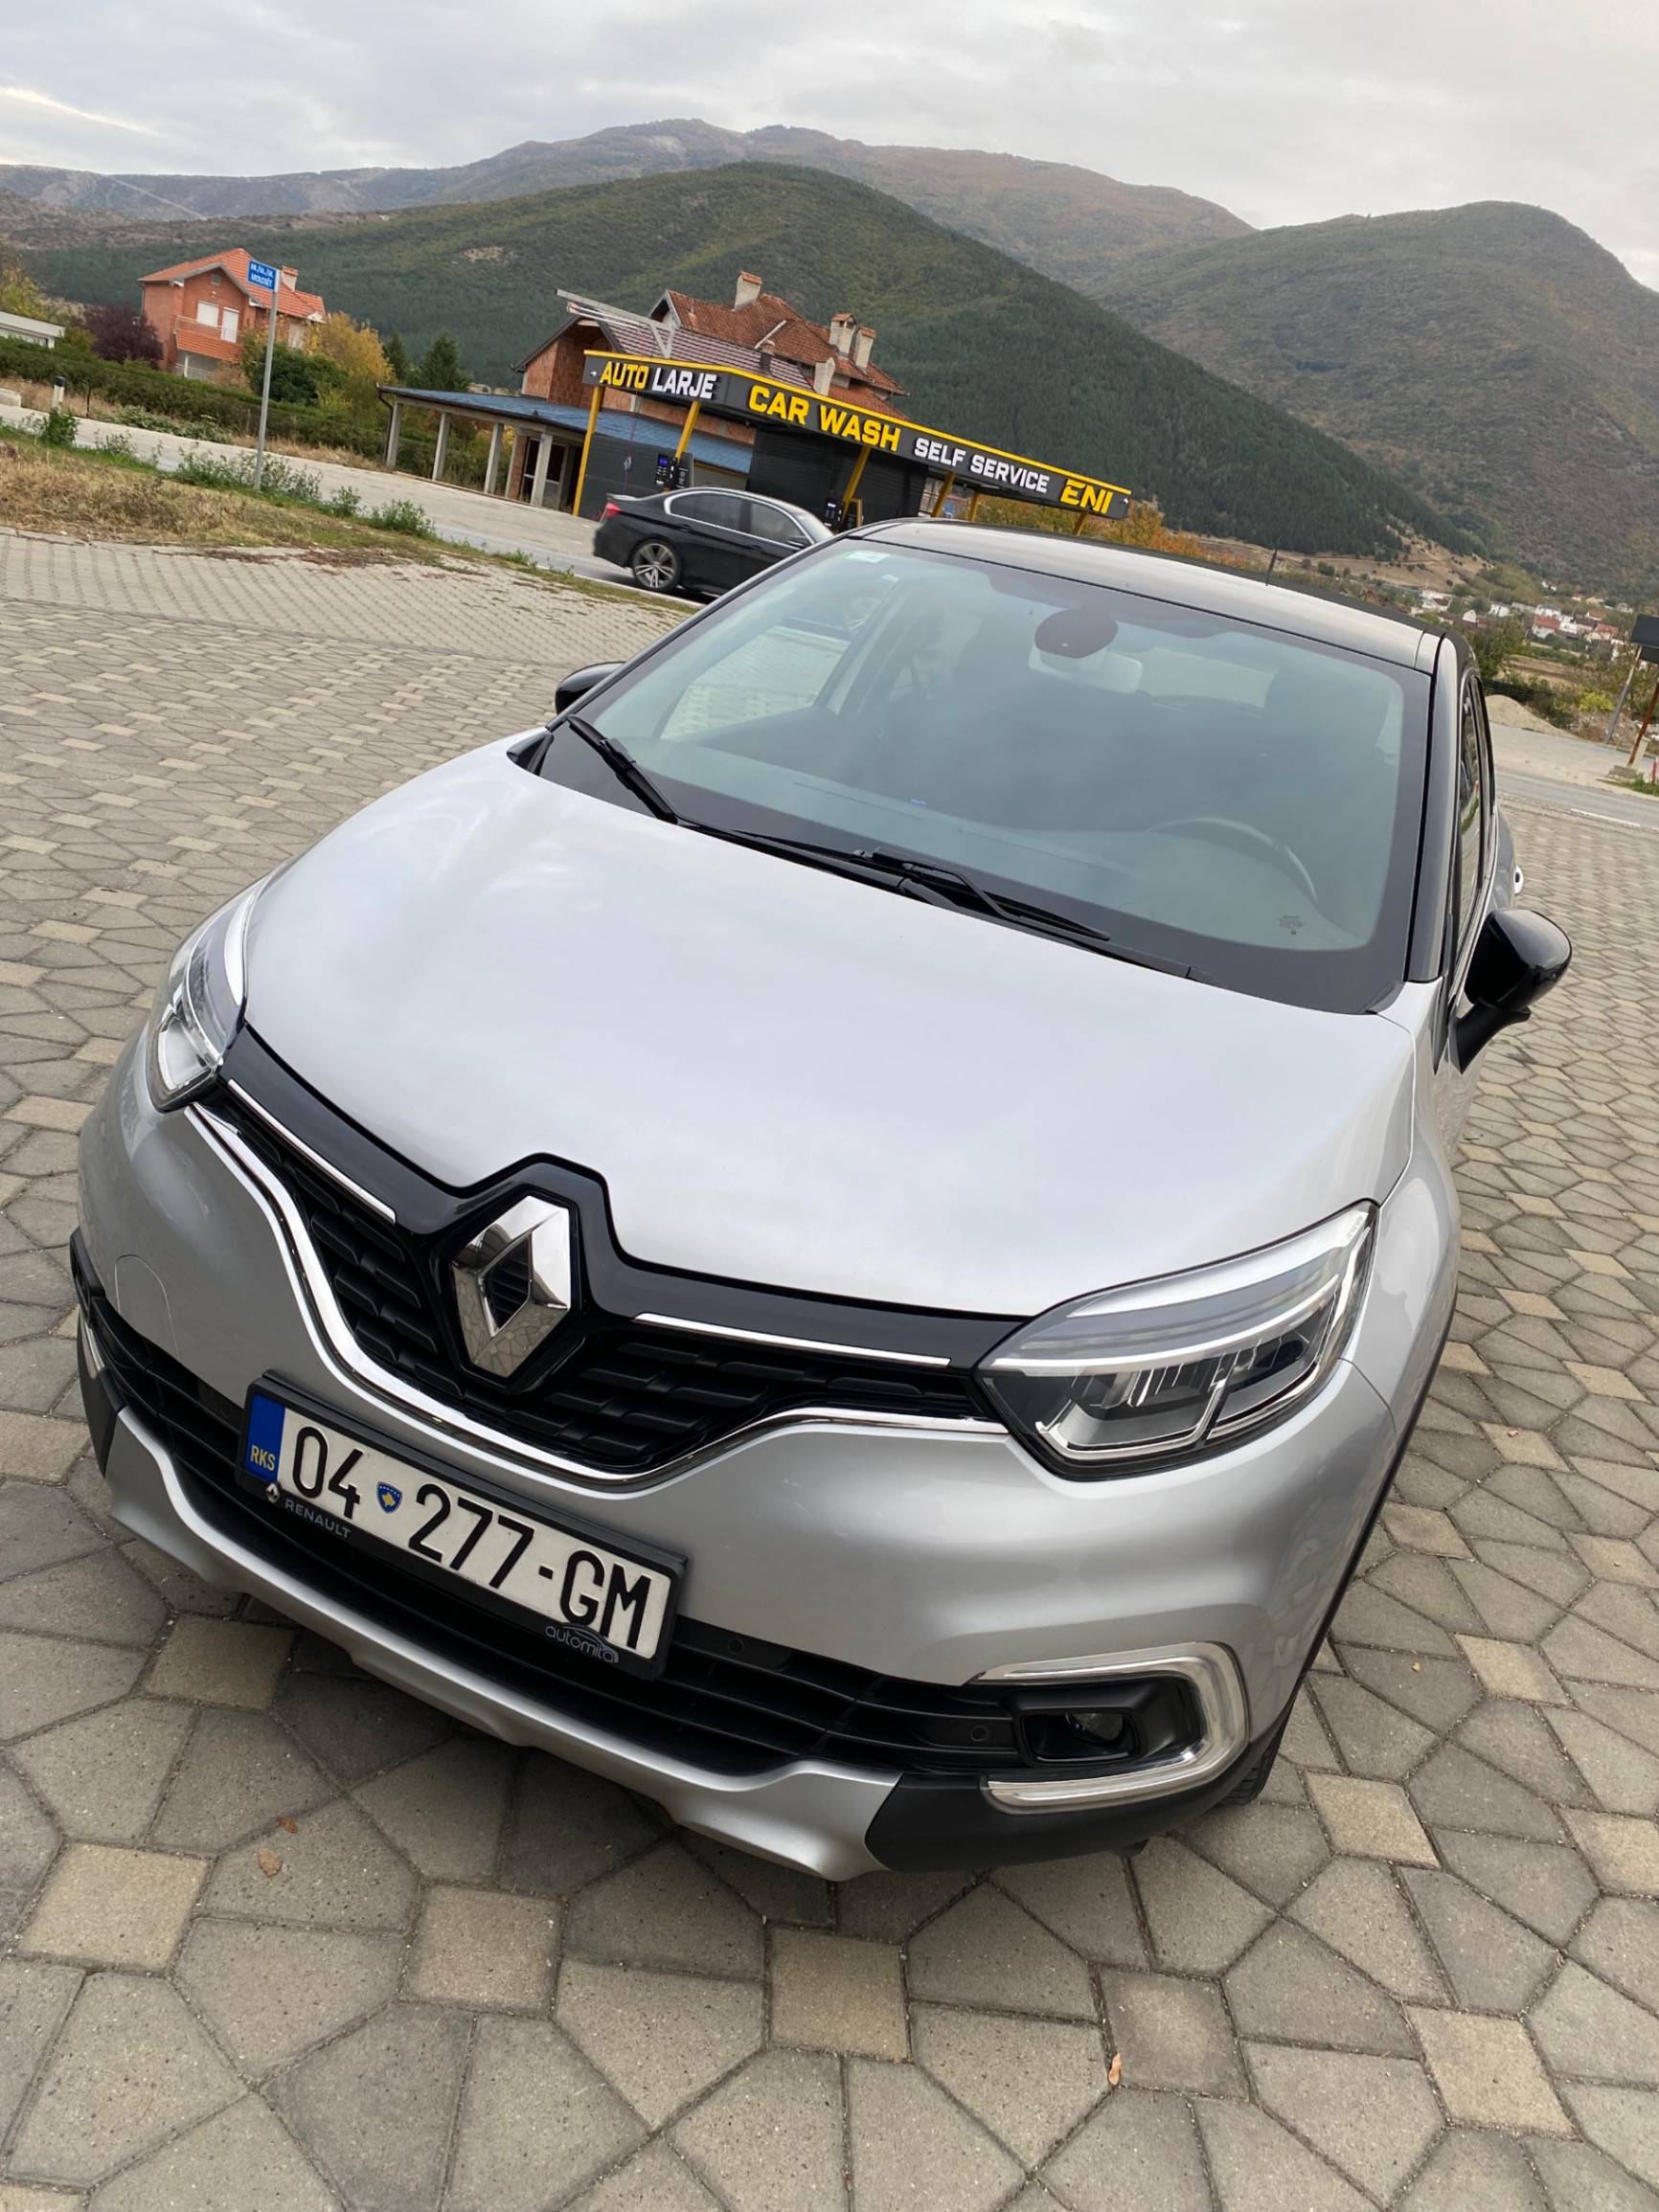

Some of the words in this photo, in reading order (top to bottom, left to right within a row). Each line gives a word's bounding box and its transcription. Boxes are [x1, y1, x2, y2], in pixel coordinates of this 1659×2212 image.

[599, 361, 649, 390] AUTO
[651, 368, 717, 399] LARJE
[749, 385, 809, 425] CAR
[819, 405, 900, 451] WASH
[914, 437, 966, 467] SELF
[970, 454, 1051, 493] SERVICE
[1060, 479, 1113, 514] ENI
[250, 1444, 276, 1471] RKS
[292, 1426, 364, 1521] 04
[284, 1498, 351, 1539] RENAULT
[545, 1625, 615, 1663] automita
